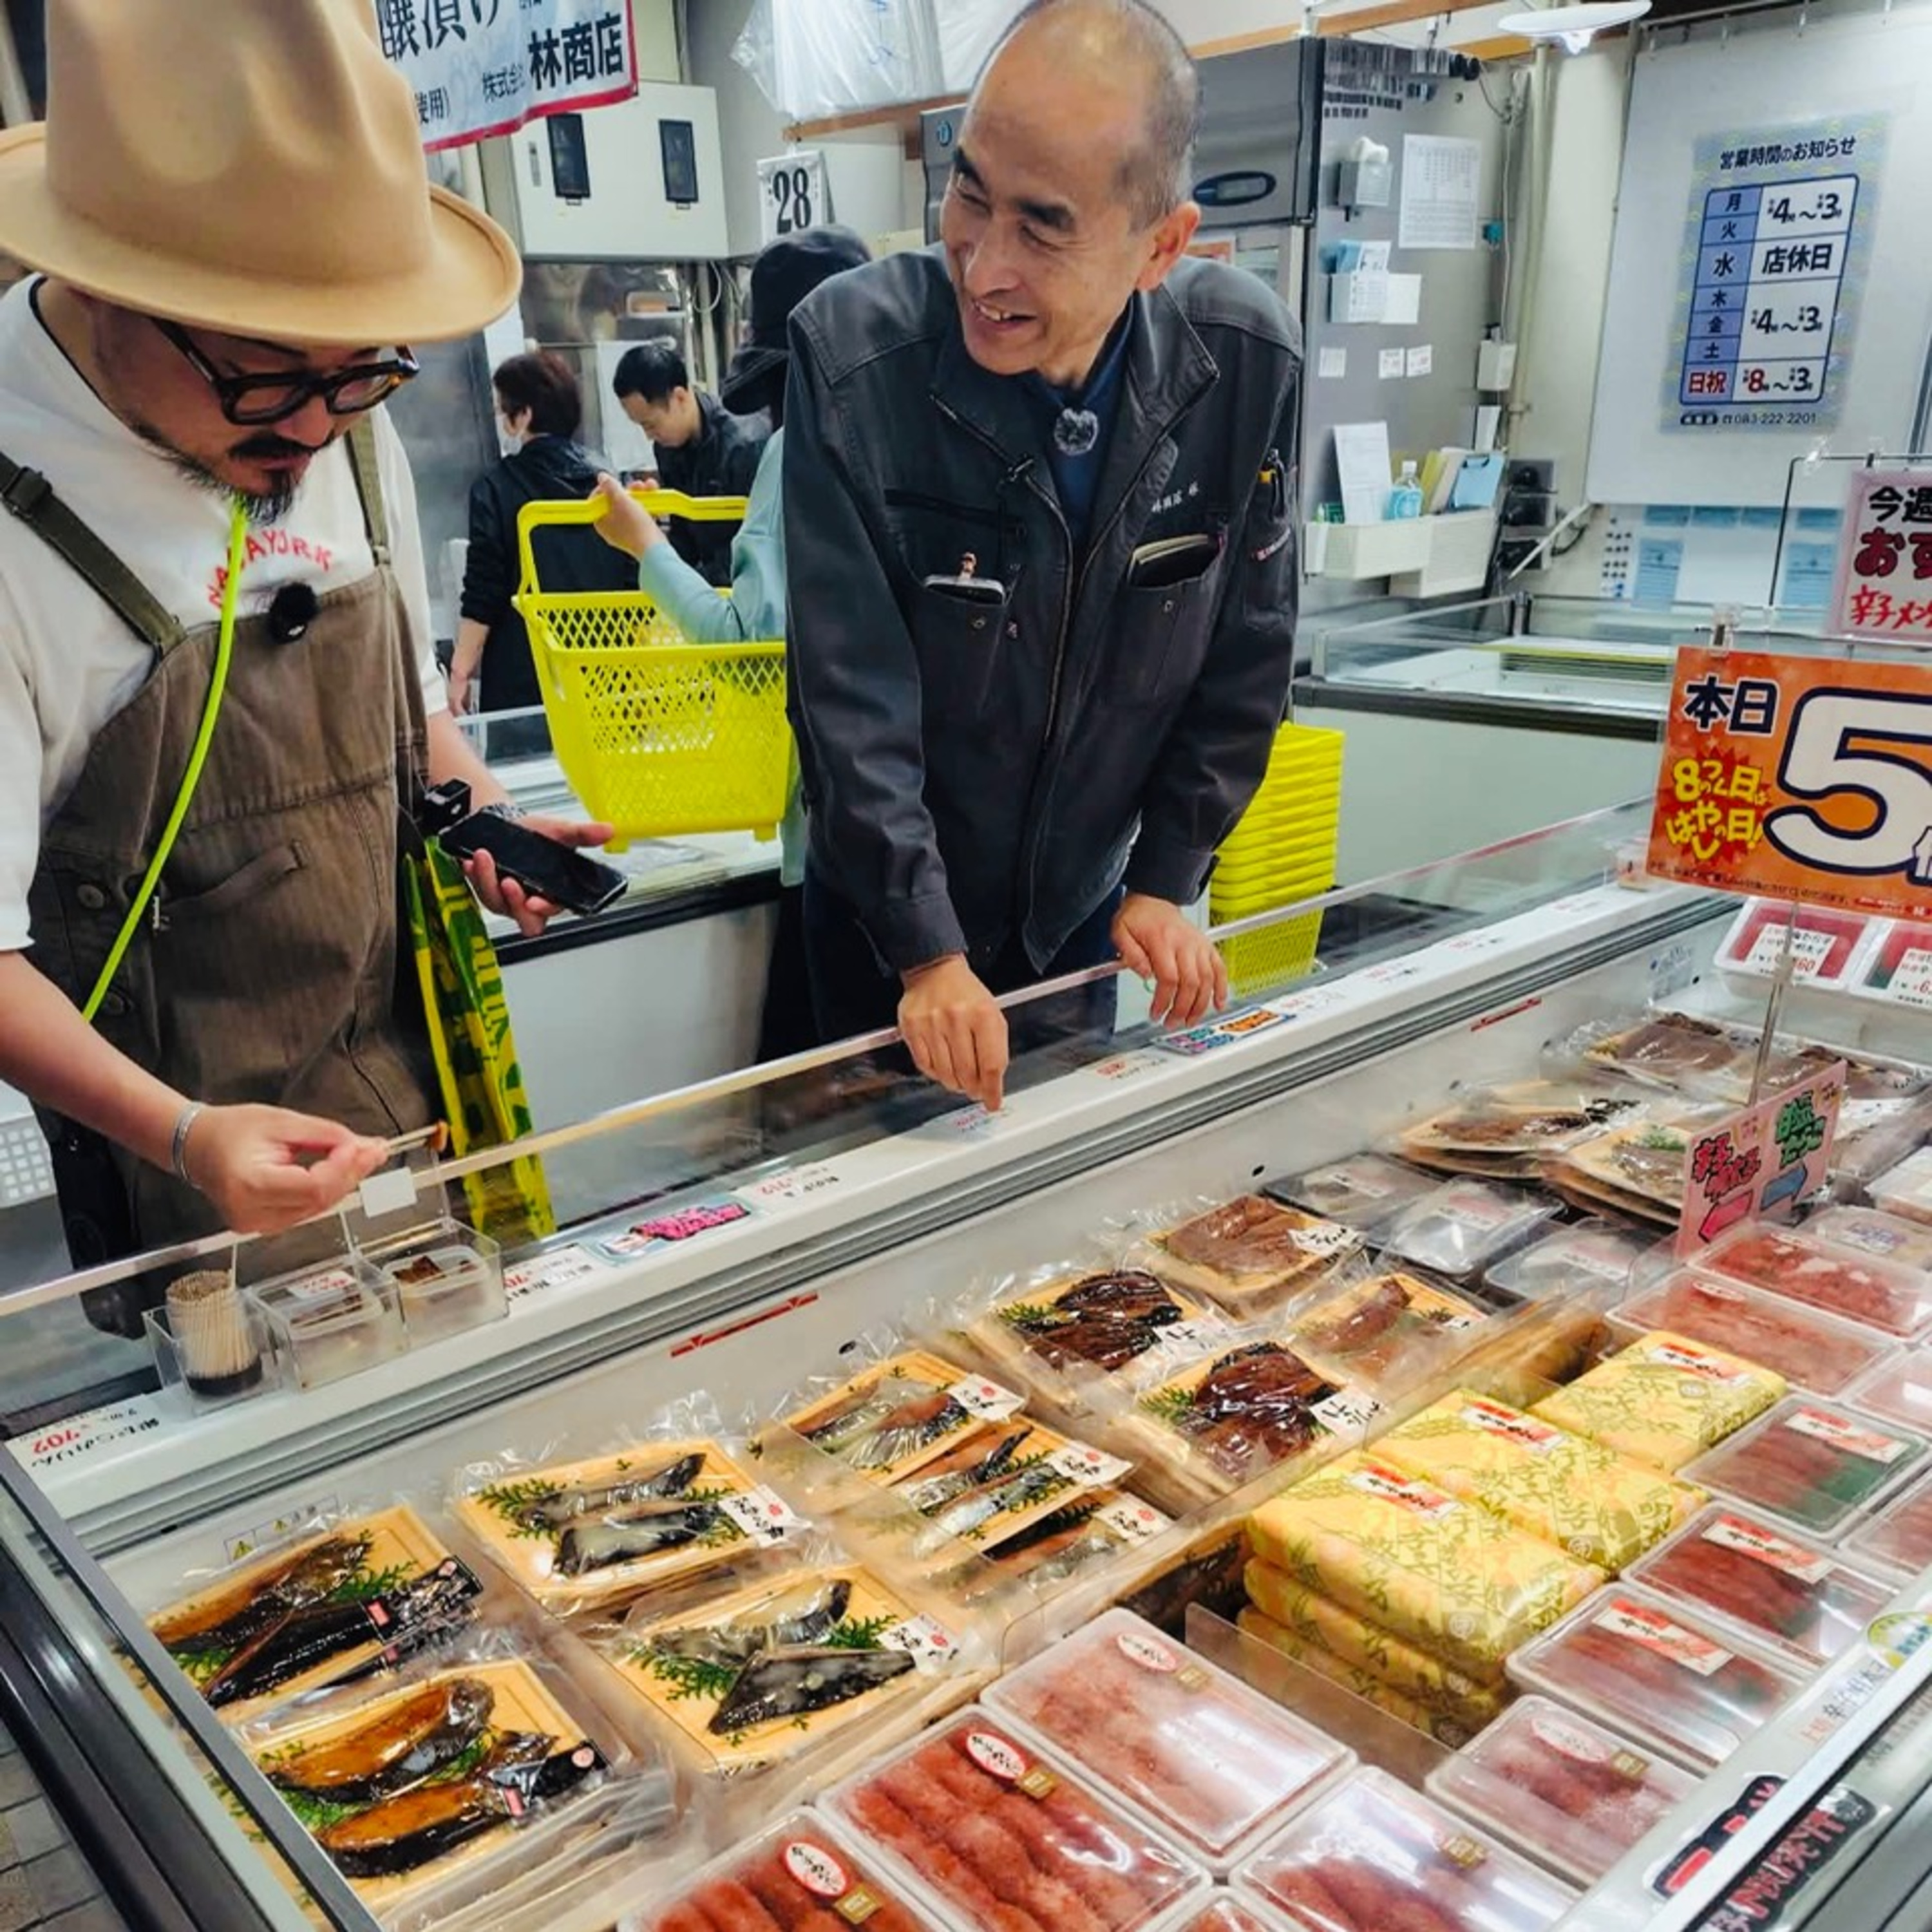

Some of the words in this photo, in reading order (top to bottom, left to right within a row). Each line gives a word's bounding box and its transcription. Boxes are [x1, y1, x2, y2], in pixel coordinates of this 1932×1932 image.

[528, 12, 625, 91] 林商店
[1719, 135, 1857, 170] 営業時間のお知らせ
[773, 167, 811, 235] 28
[1725, 193, 1742, 212] 月
[1721, 221, 1738, 240] 火
[1713, 251, 1735, 278] 水
[1762, 243, 1833, 274] 店休日
[1710, 289, 1728, 308] 木
[1707, 315, 1725, 334] 金
[1703, 342, 1721, 359] 土
[1687, 370, 1728, 393] 日祝
[1868, 486, 1932, 523] 今週
[1683, 676, 1778, 734] 本日
